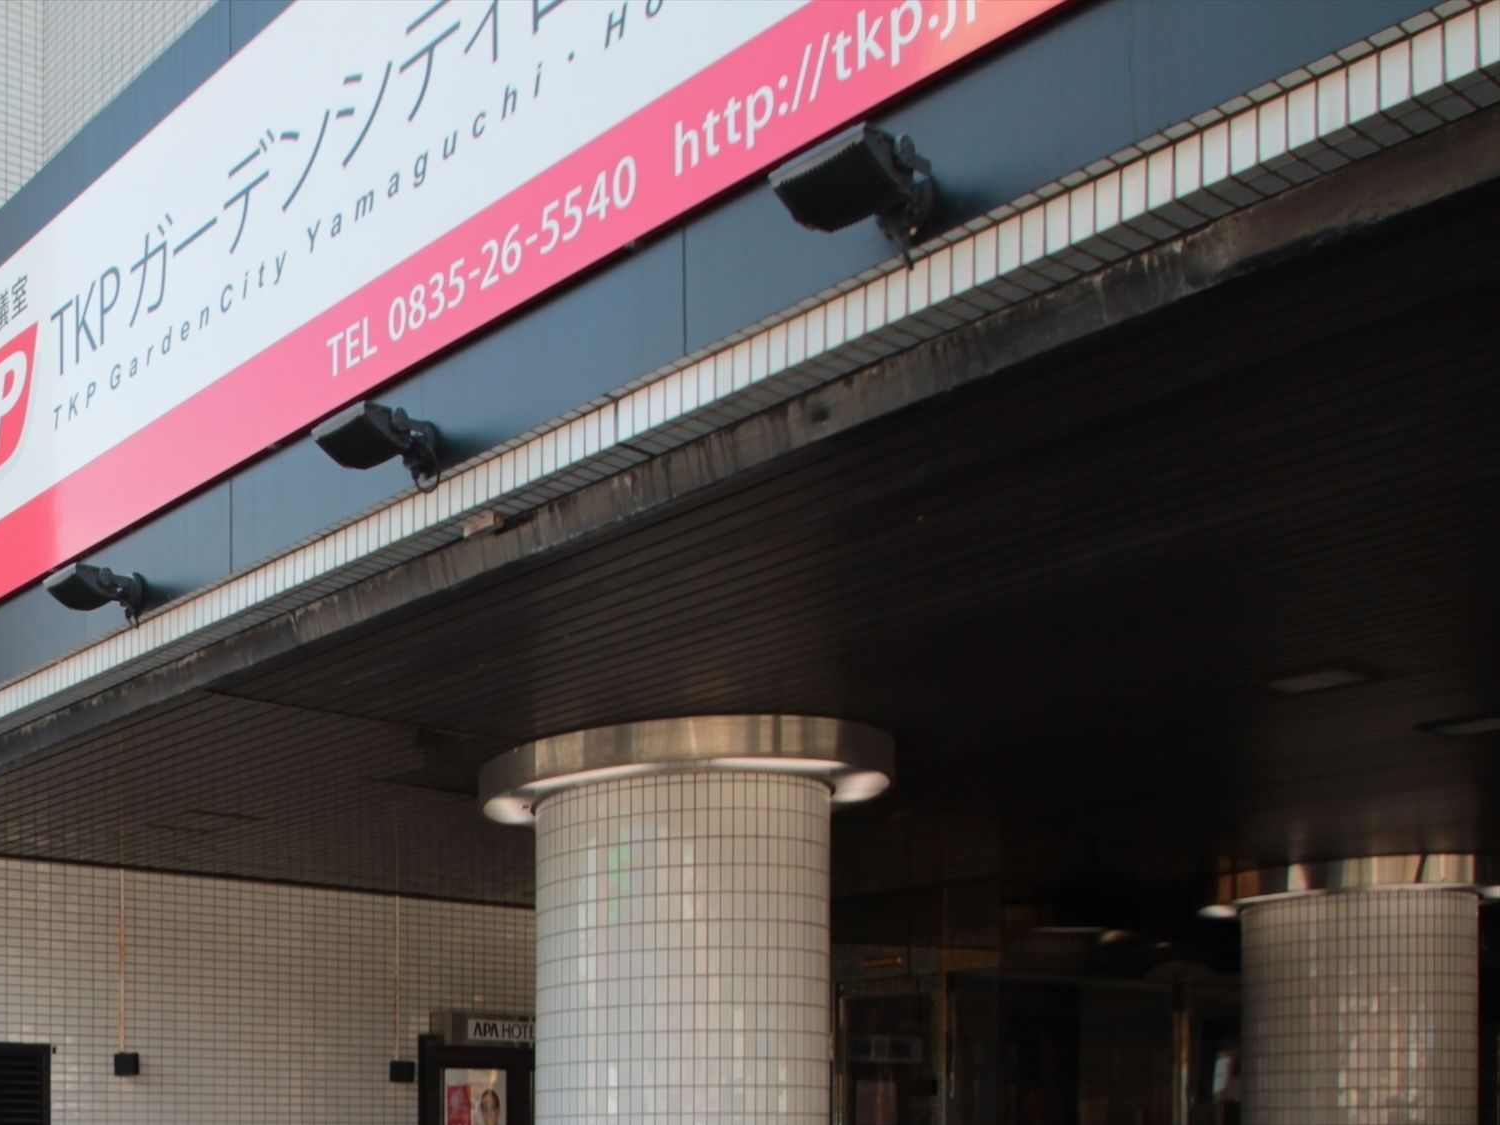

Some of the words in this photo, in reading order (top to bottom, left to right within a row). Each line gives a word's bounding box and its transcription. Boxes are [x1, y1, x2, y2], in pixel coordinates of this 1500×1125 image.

[326, 316, 378, 377] TEL
[388, 155, 637, 342] 0835-26-5540
[53, 381, 97, 431] TKP
[473, 1021, 499, 1038] APA
